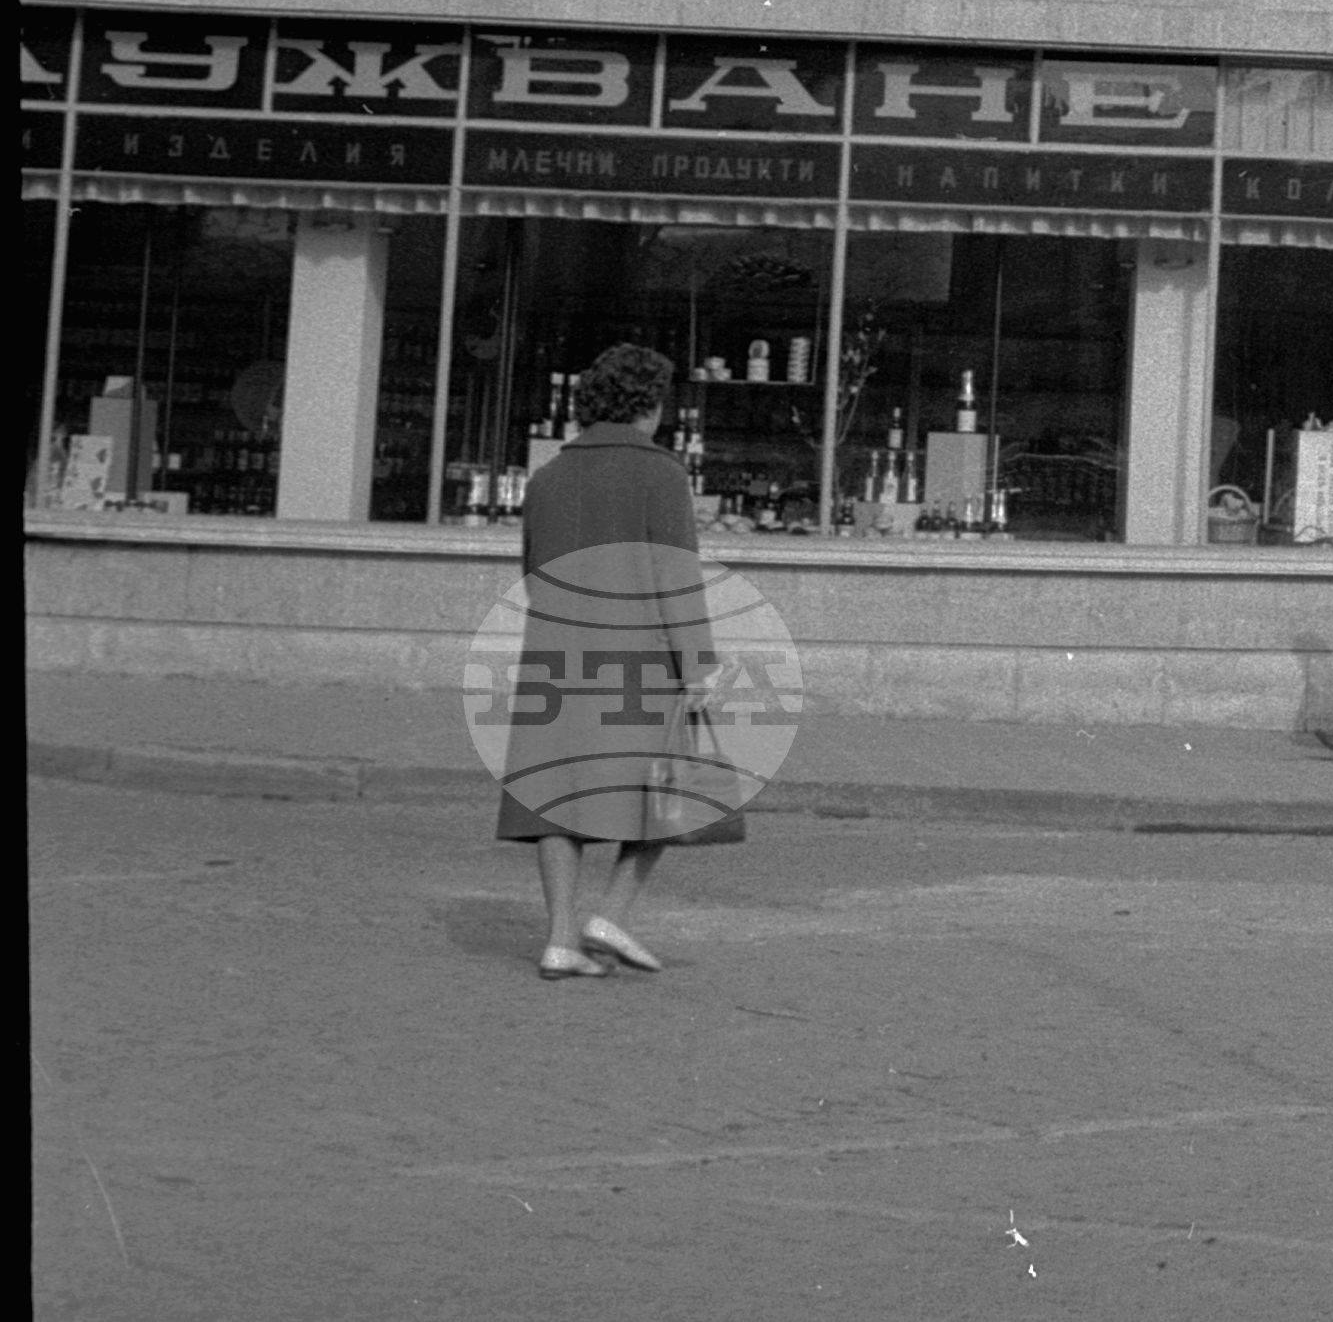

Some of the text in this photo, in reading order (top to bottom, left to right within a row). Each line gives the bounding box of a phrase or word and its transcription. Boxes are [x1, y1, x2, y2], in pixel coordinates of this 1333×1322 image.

[20, 27, 1190, 129] УЖВАНЕ
[123, 132, 404, 166] ИЗДЕЛИЯ
[487, 148, 814, 183] МЛЕЧНИ ПРОДУКТИ
[898, 164, 1168, 196] НАПИТКИ
